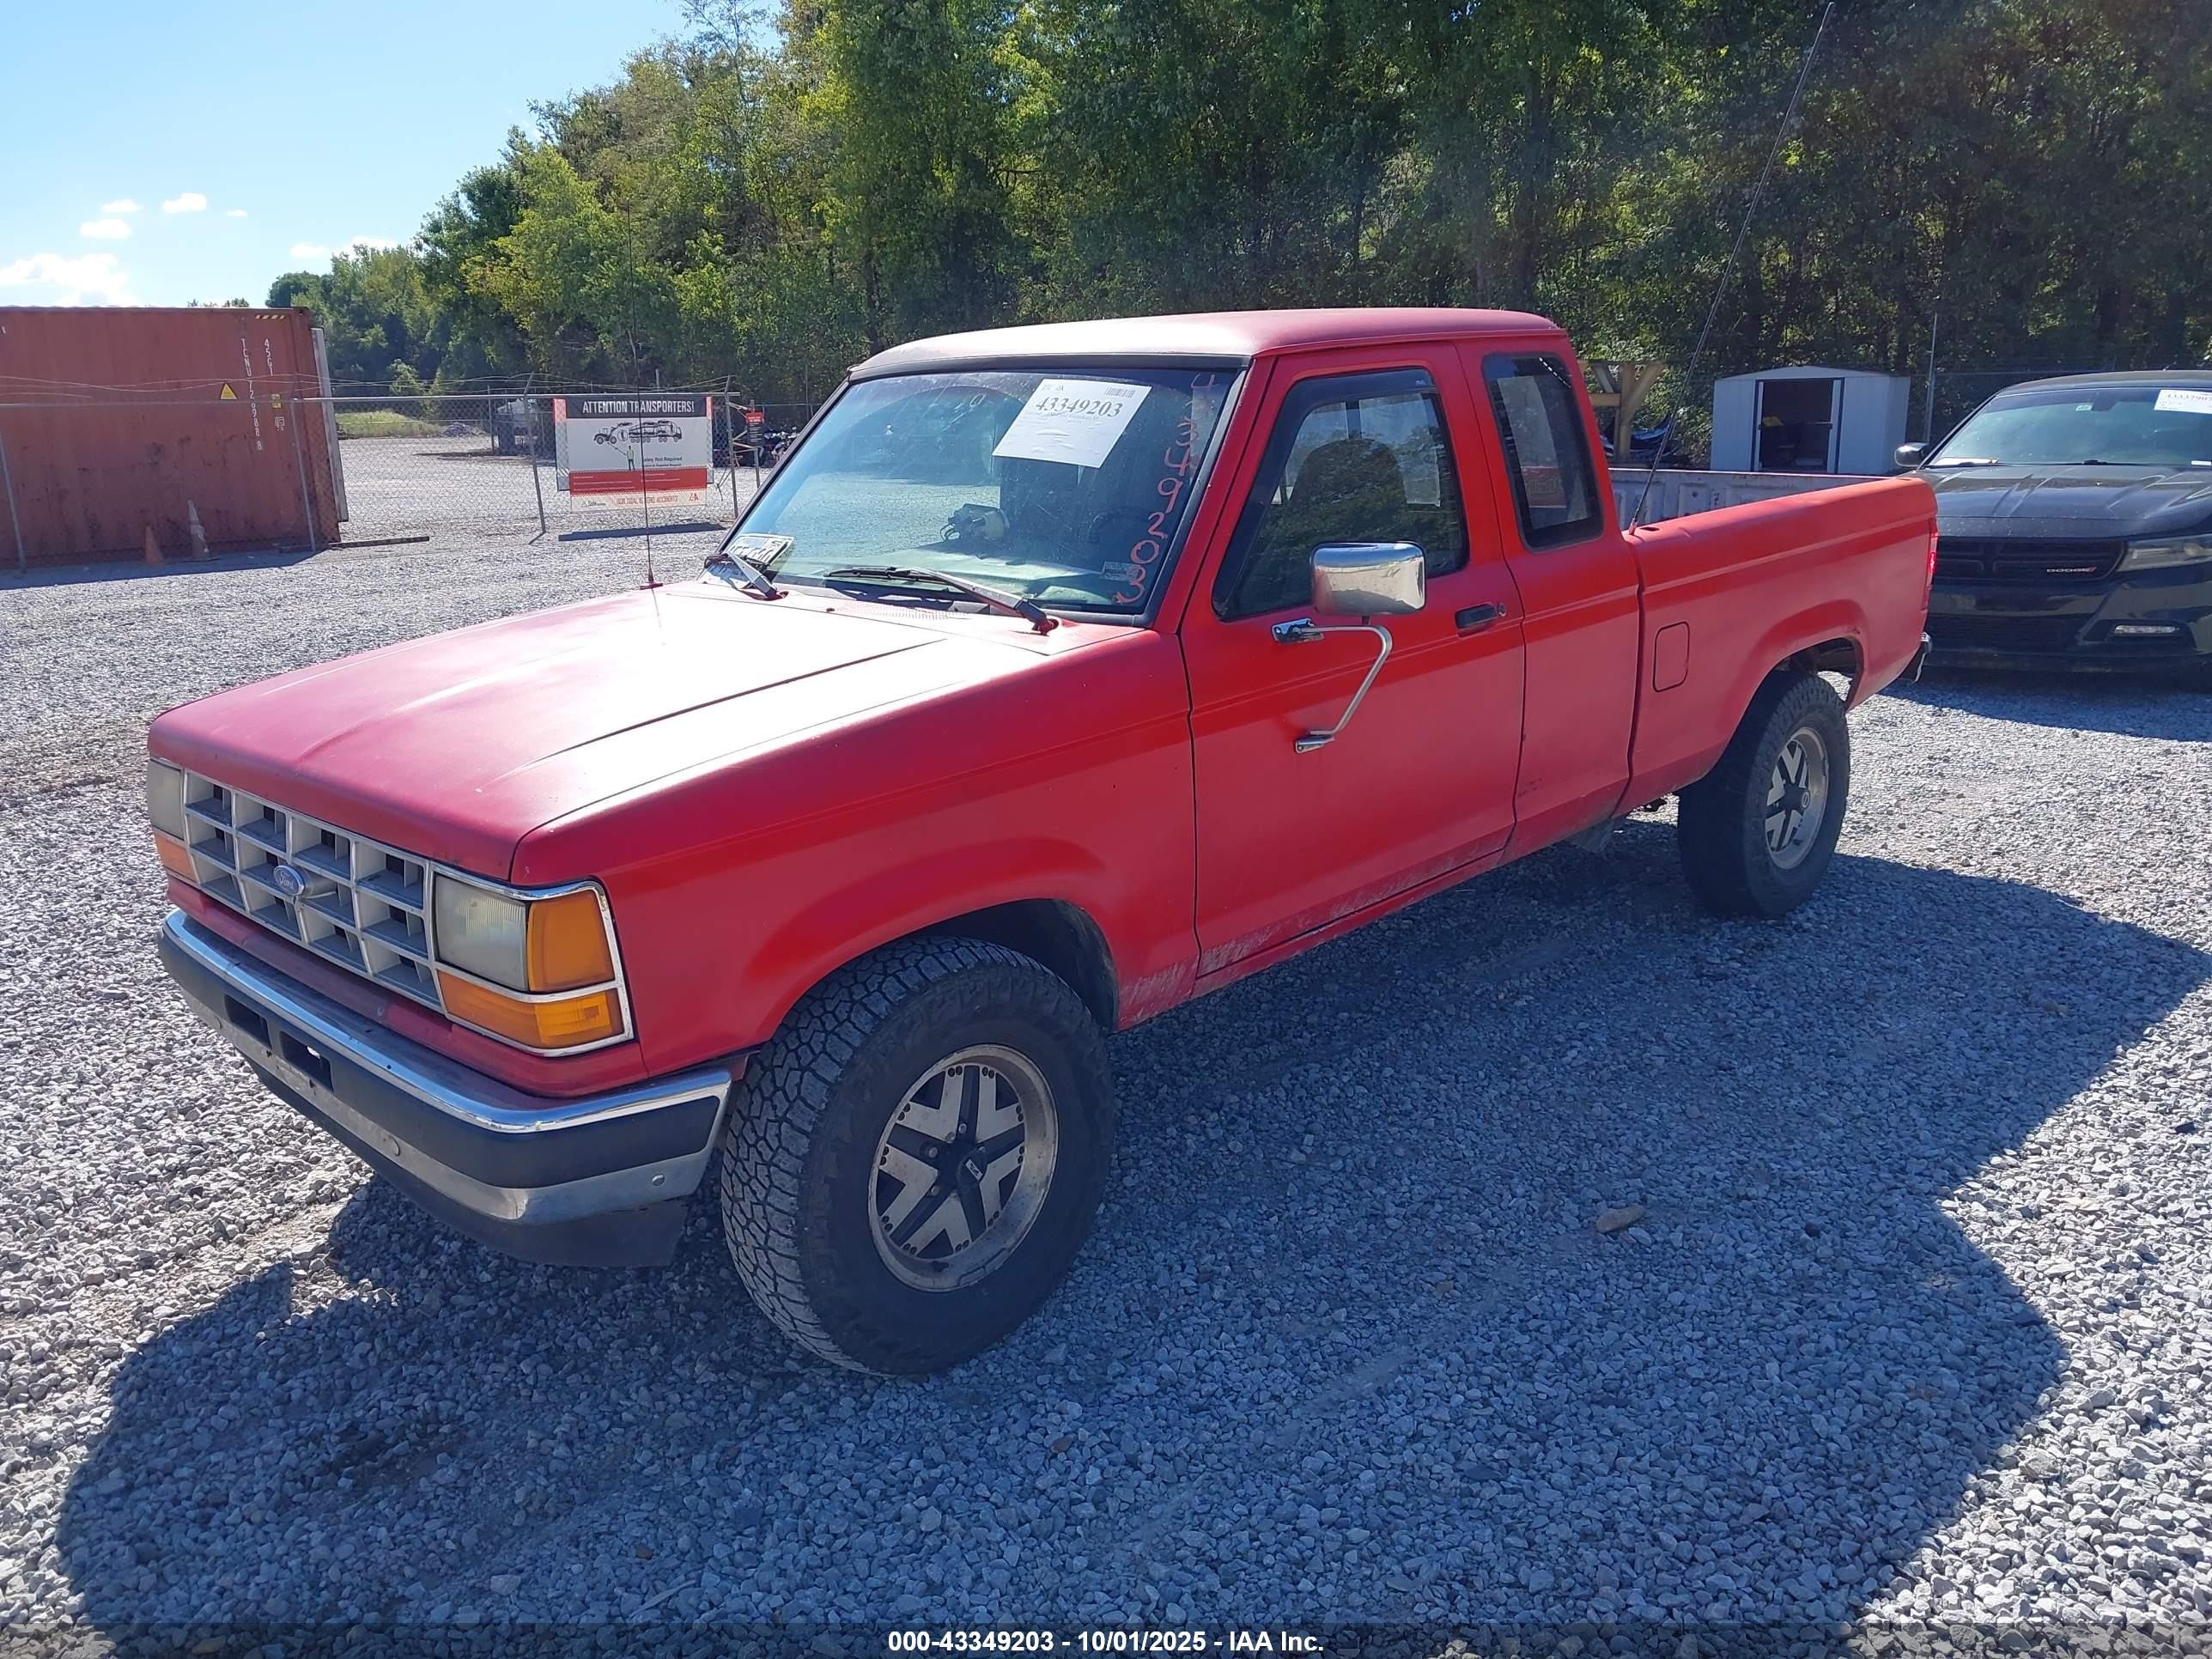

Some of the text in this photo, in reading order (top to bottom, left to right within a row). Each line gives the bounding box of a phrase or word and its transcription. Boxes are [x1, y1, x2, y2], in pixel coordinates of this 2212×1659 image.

[240, 337, 252, 377] TCNU
[582, 398, 696, 414] ATTENTION TRANSPORTERS!
[1036, 397, 1124, 418] 43349203
[275, 870, 295, 890] Ford
